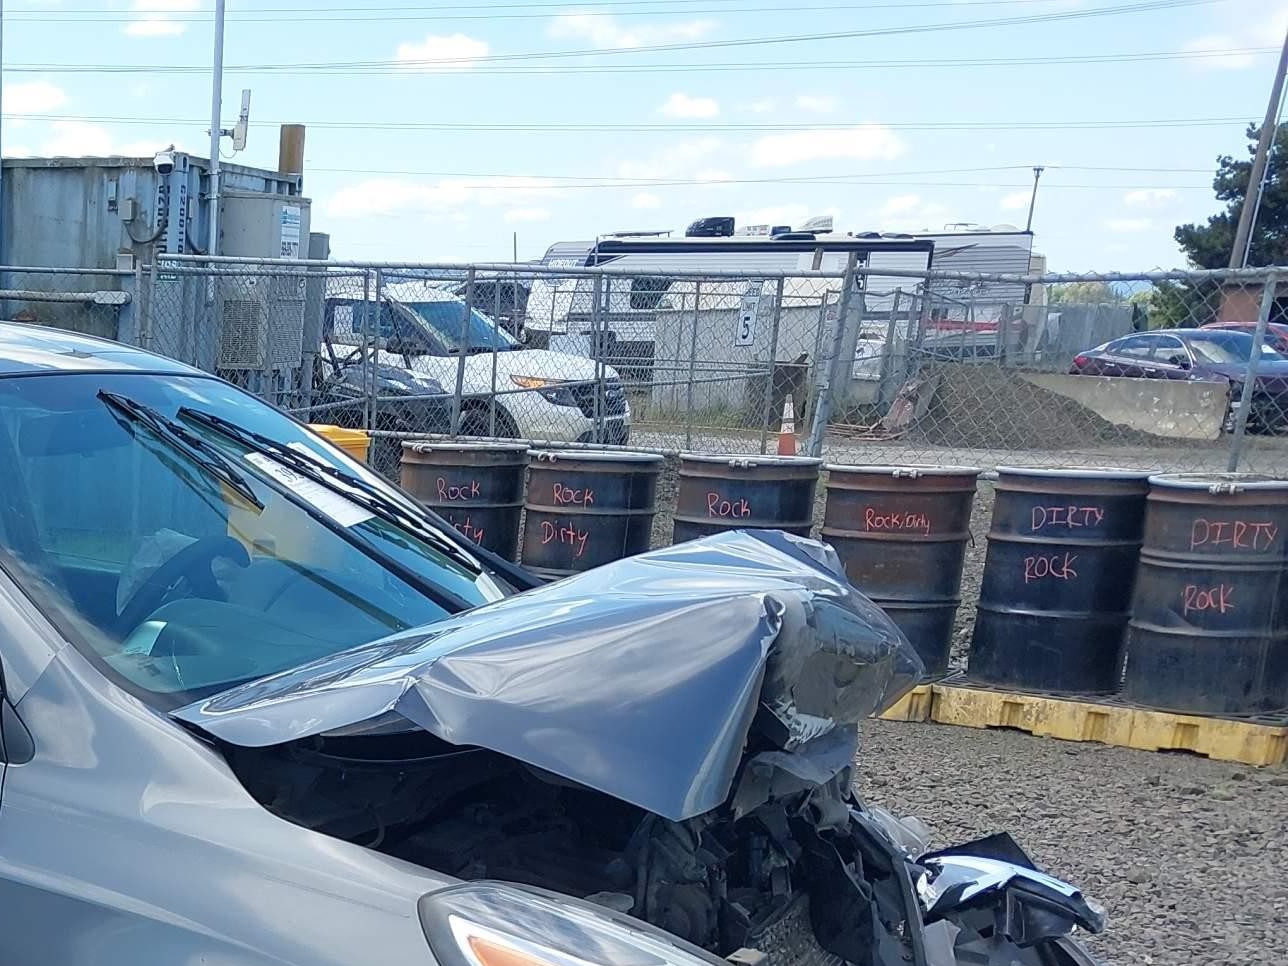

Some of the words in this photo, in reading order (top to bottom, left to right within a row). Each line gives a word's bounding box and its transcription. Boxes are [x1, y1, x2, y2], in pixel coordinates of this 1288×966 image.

[741, 316, 751, 340] 5
[1031, 505, 1105, 531] DIRTY
[1190, 518, 1279, 551] DIRTY
[1024, 552, 1078, 584] ROCK
[1183, 584, 1235, 616] ROCK
